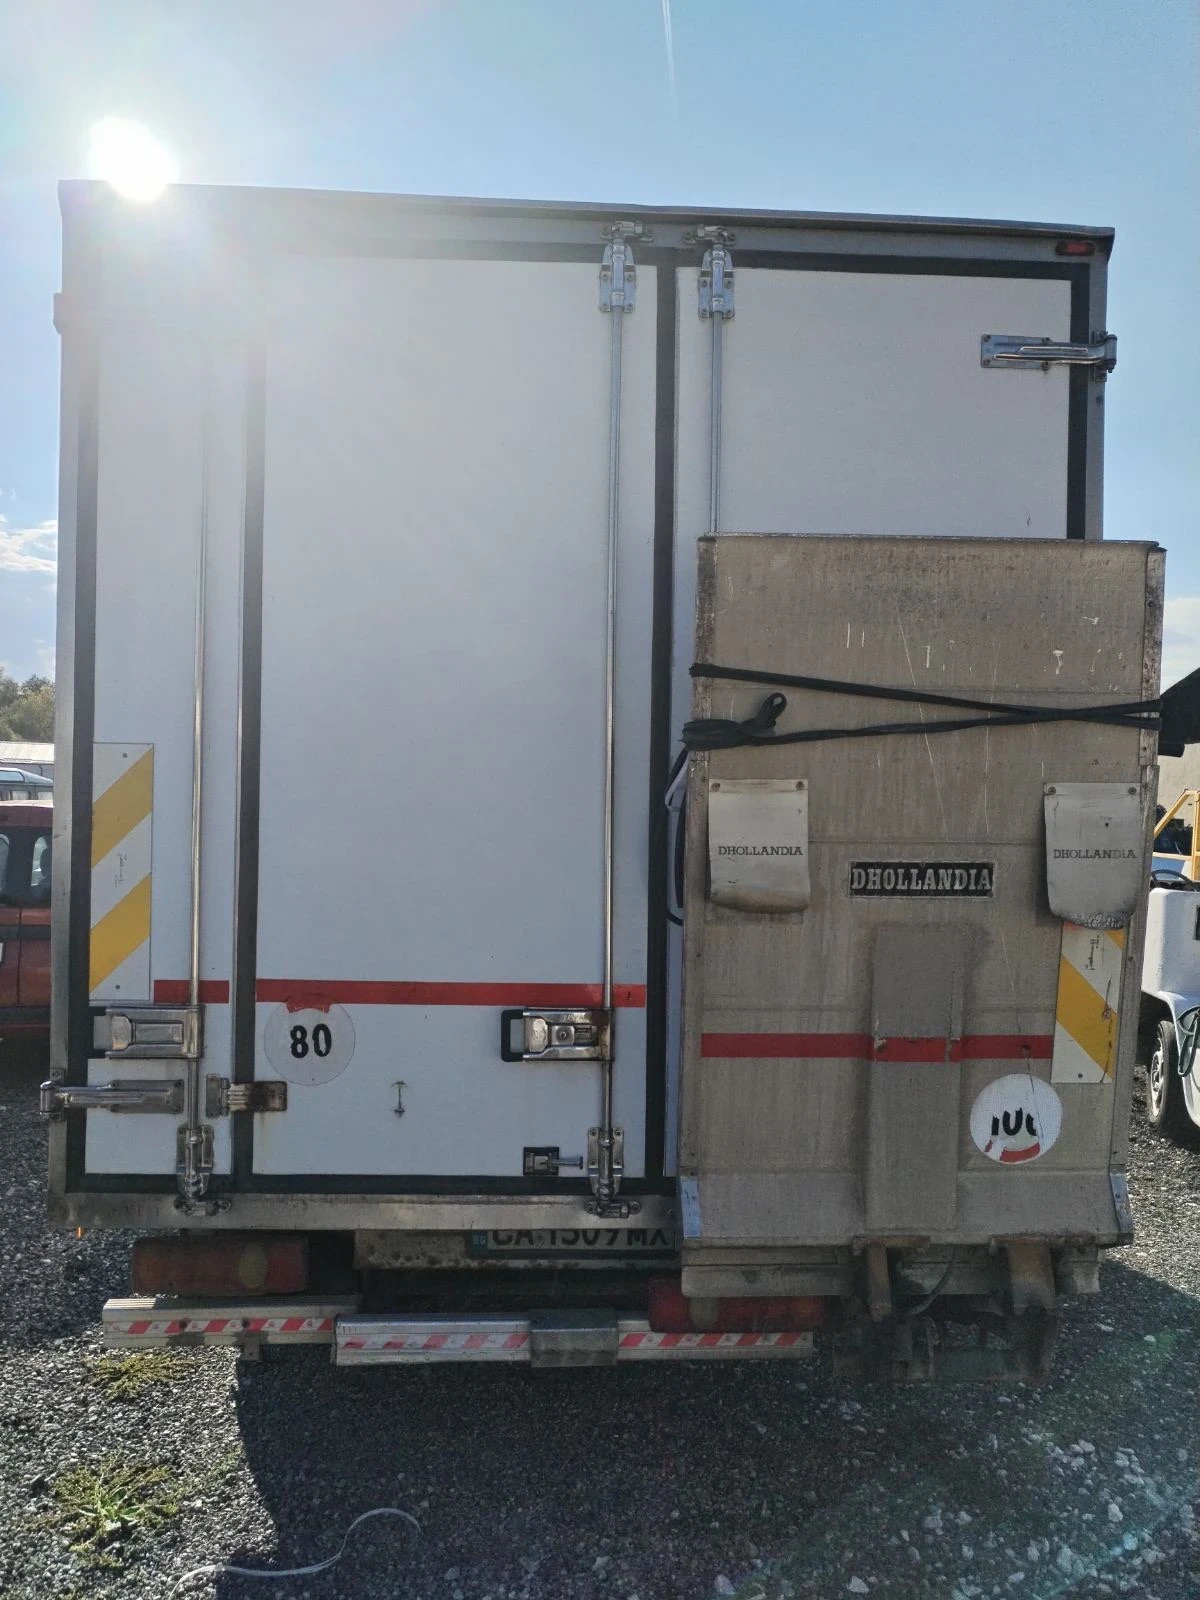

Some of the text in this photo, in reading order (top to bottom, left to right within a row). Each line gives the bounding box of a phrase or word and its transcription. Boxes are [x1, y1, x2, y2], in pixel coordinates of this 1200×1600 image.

[718, 846, 804, 856] DHOLLANDIA
[1053, 849, 1138, 859] DHOLLANDIA
[851, 868, 992, 890] DHOLLANDIA
[290, 1023, 332, 1058] 80
